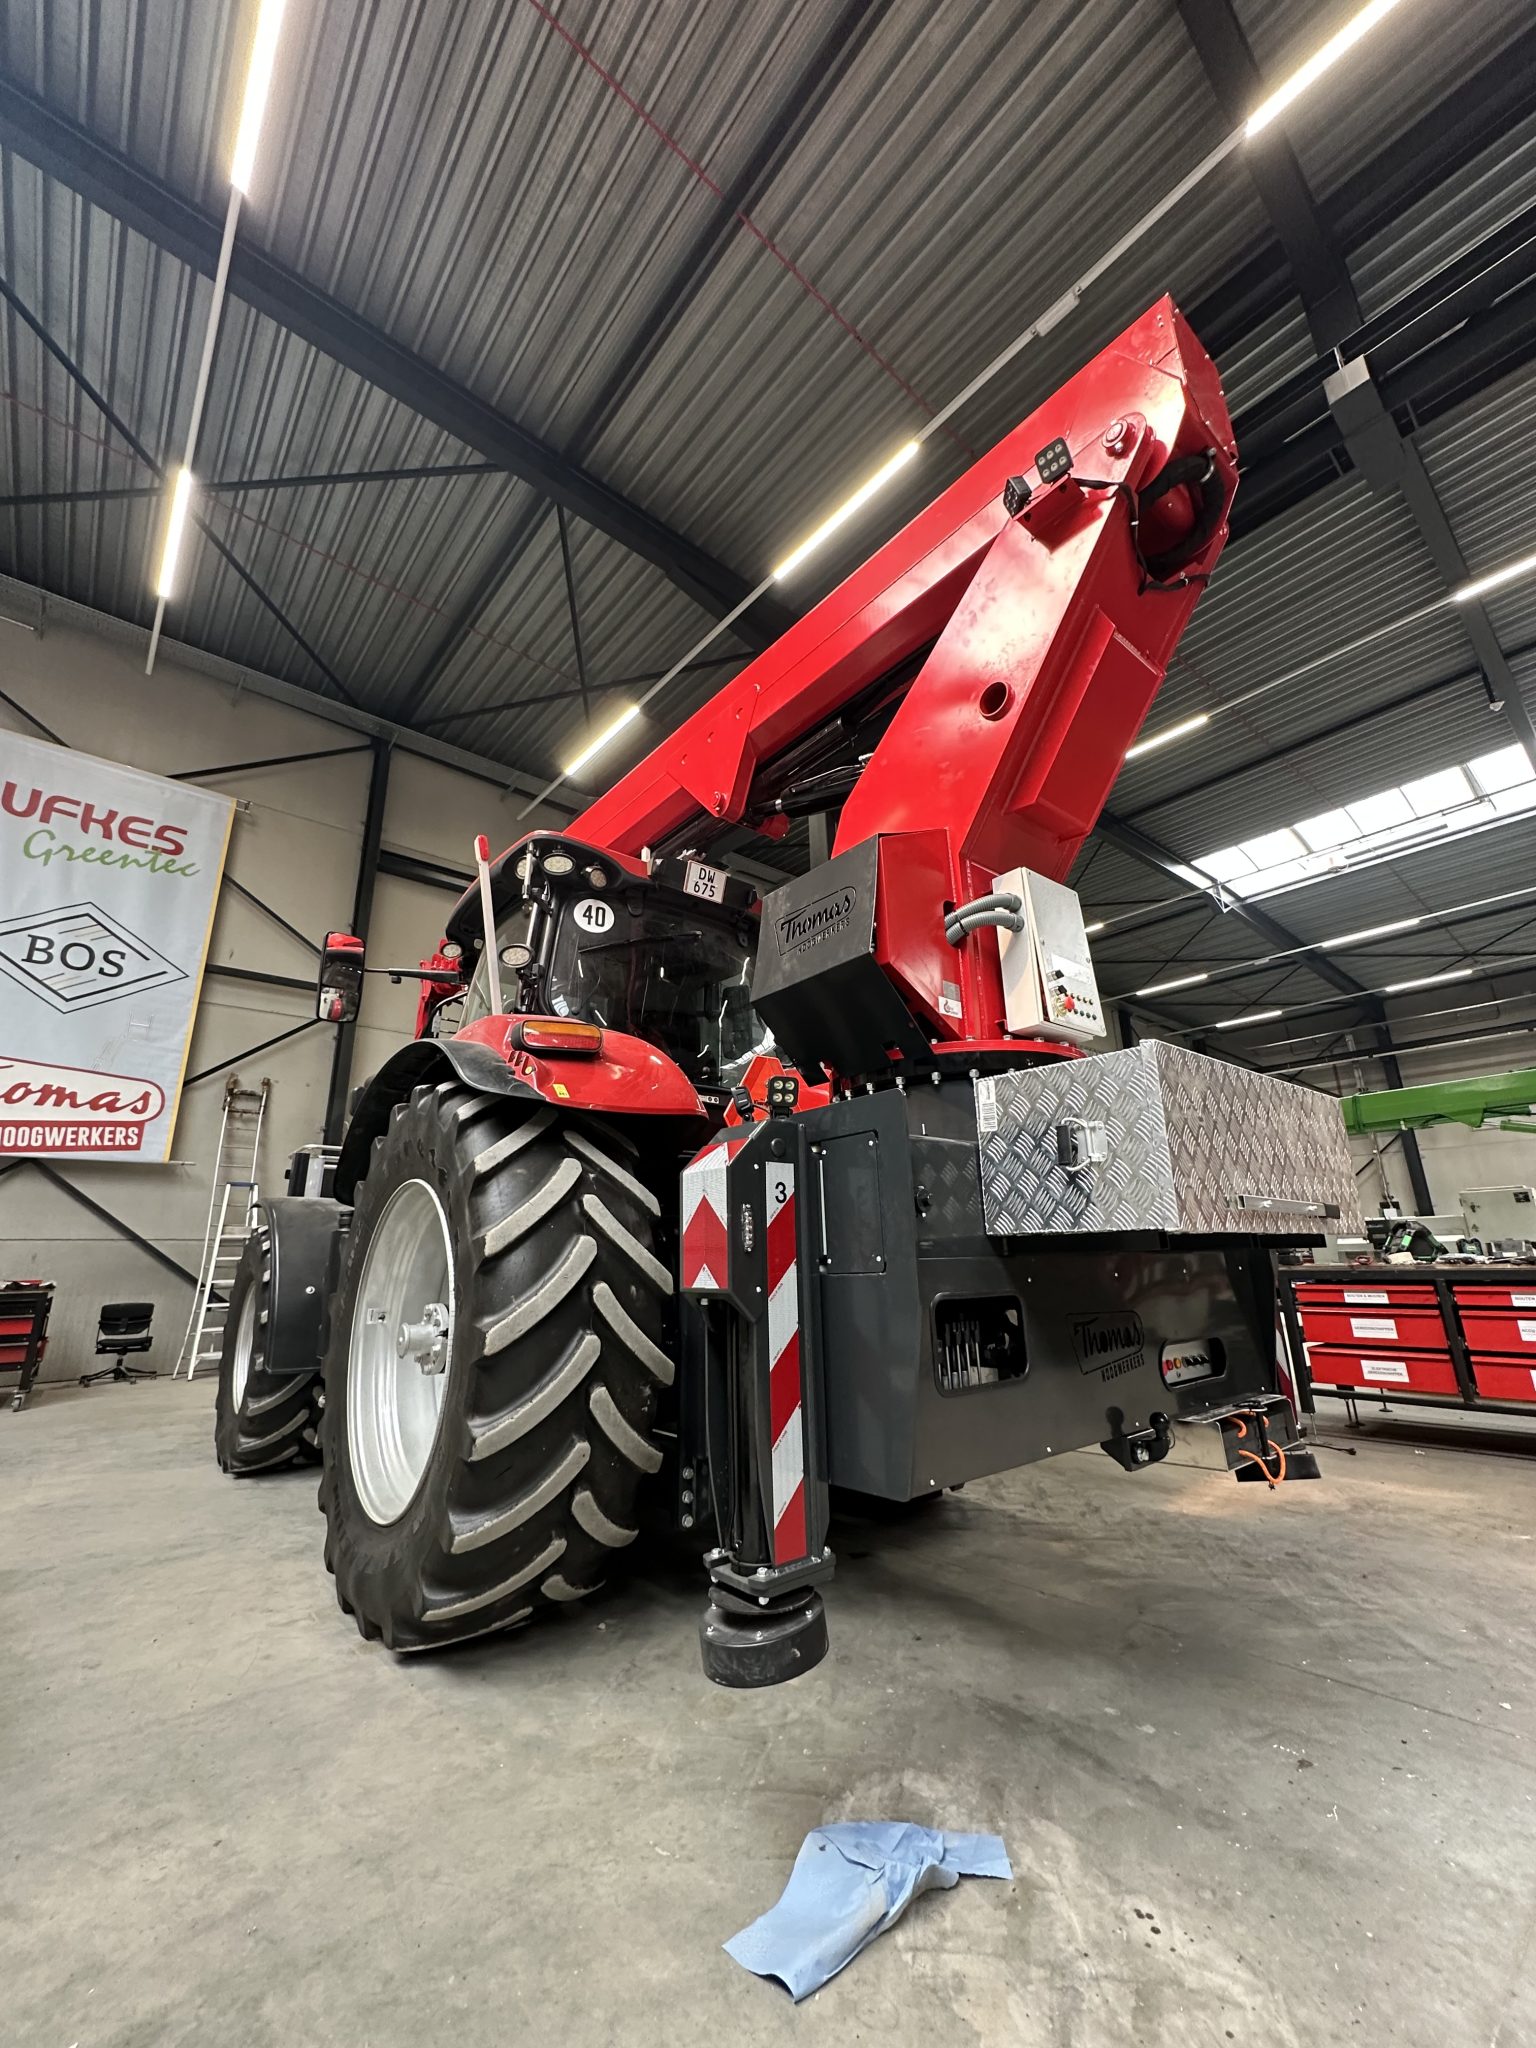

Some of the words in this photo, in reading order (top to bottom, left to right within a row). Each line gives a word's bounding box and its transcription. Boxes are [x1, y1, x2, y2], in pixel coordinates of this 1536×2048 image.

[2, 780, 188, 857] UFKES
[23, 829, 200, 878] Greentec
[693, 880, 716, 898] 675
[698, 867, 716, 884] DW
[582, 904, 606, 928] 40
[781, 894, 851, 944] Thomas
[21, 934, 127, 978] BOS
[0, 1065, 152, 1115] omas
[0, 1126, 139, 1148] OOGWERKERS
[775, 1181, 787, 1204] 3
[1073, 1316, 1141, 1358] Thomas
